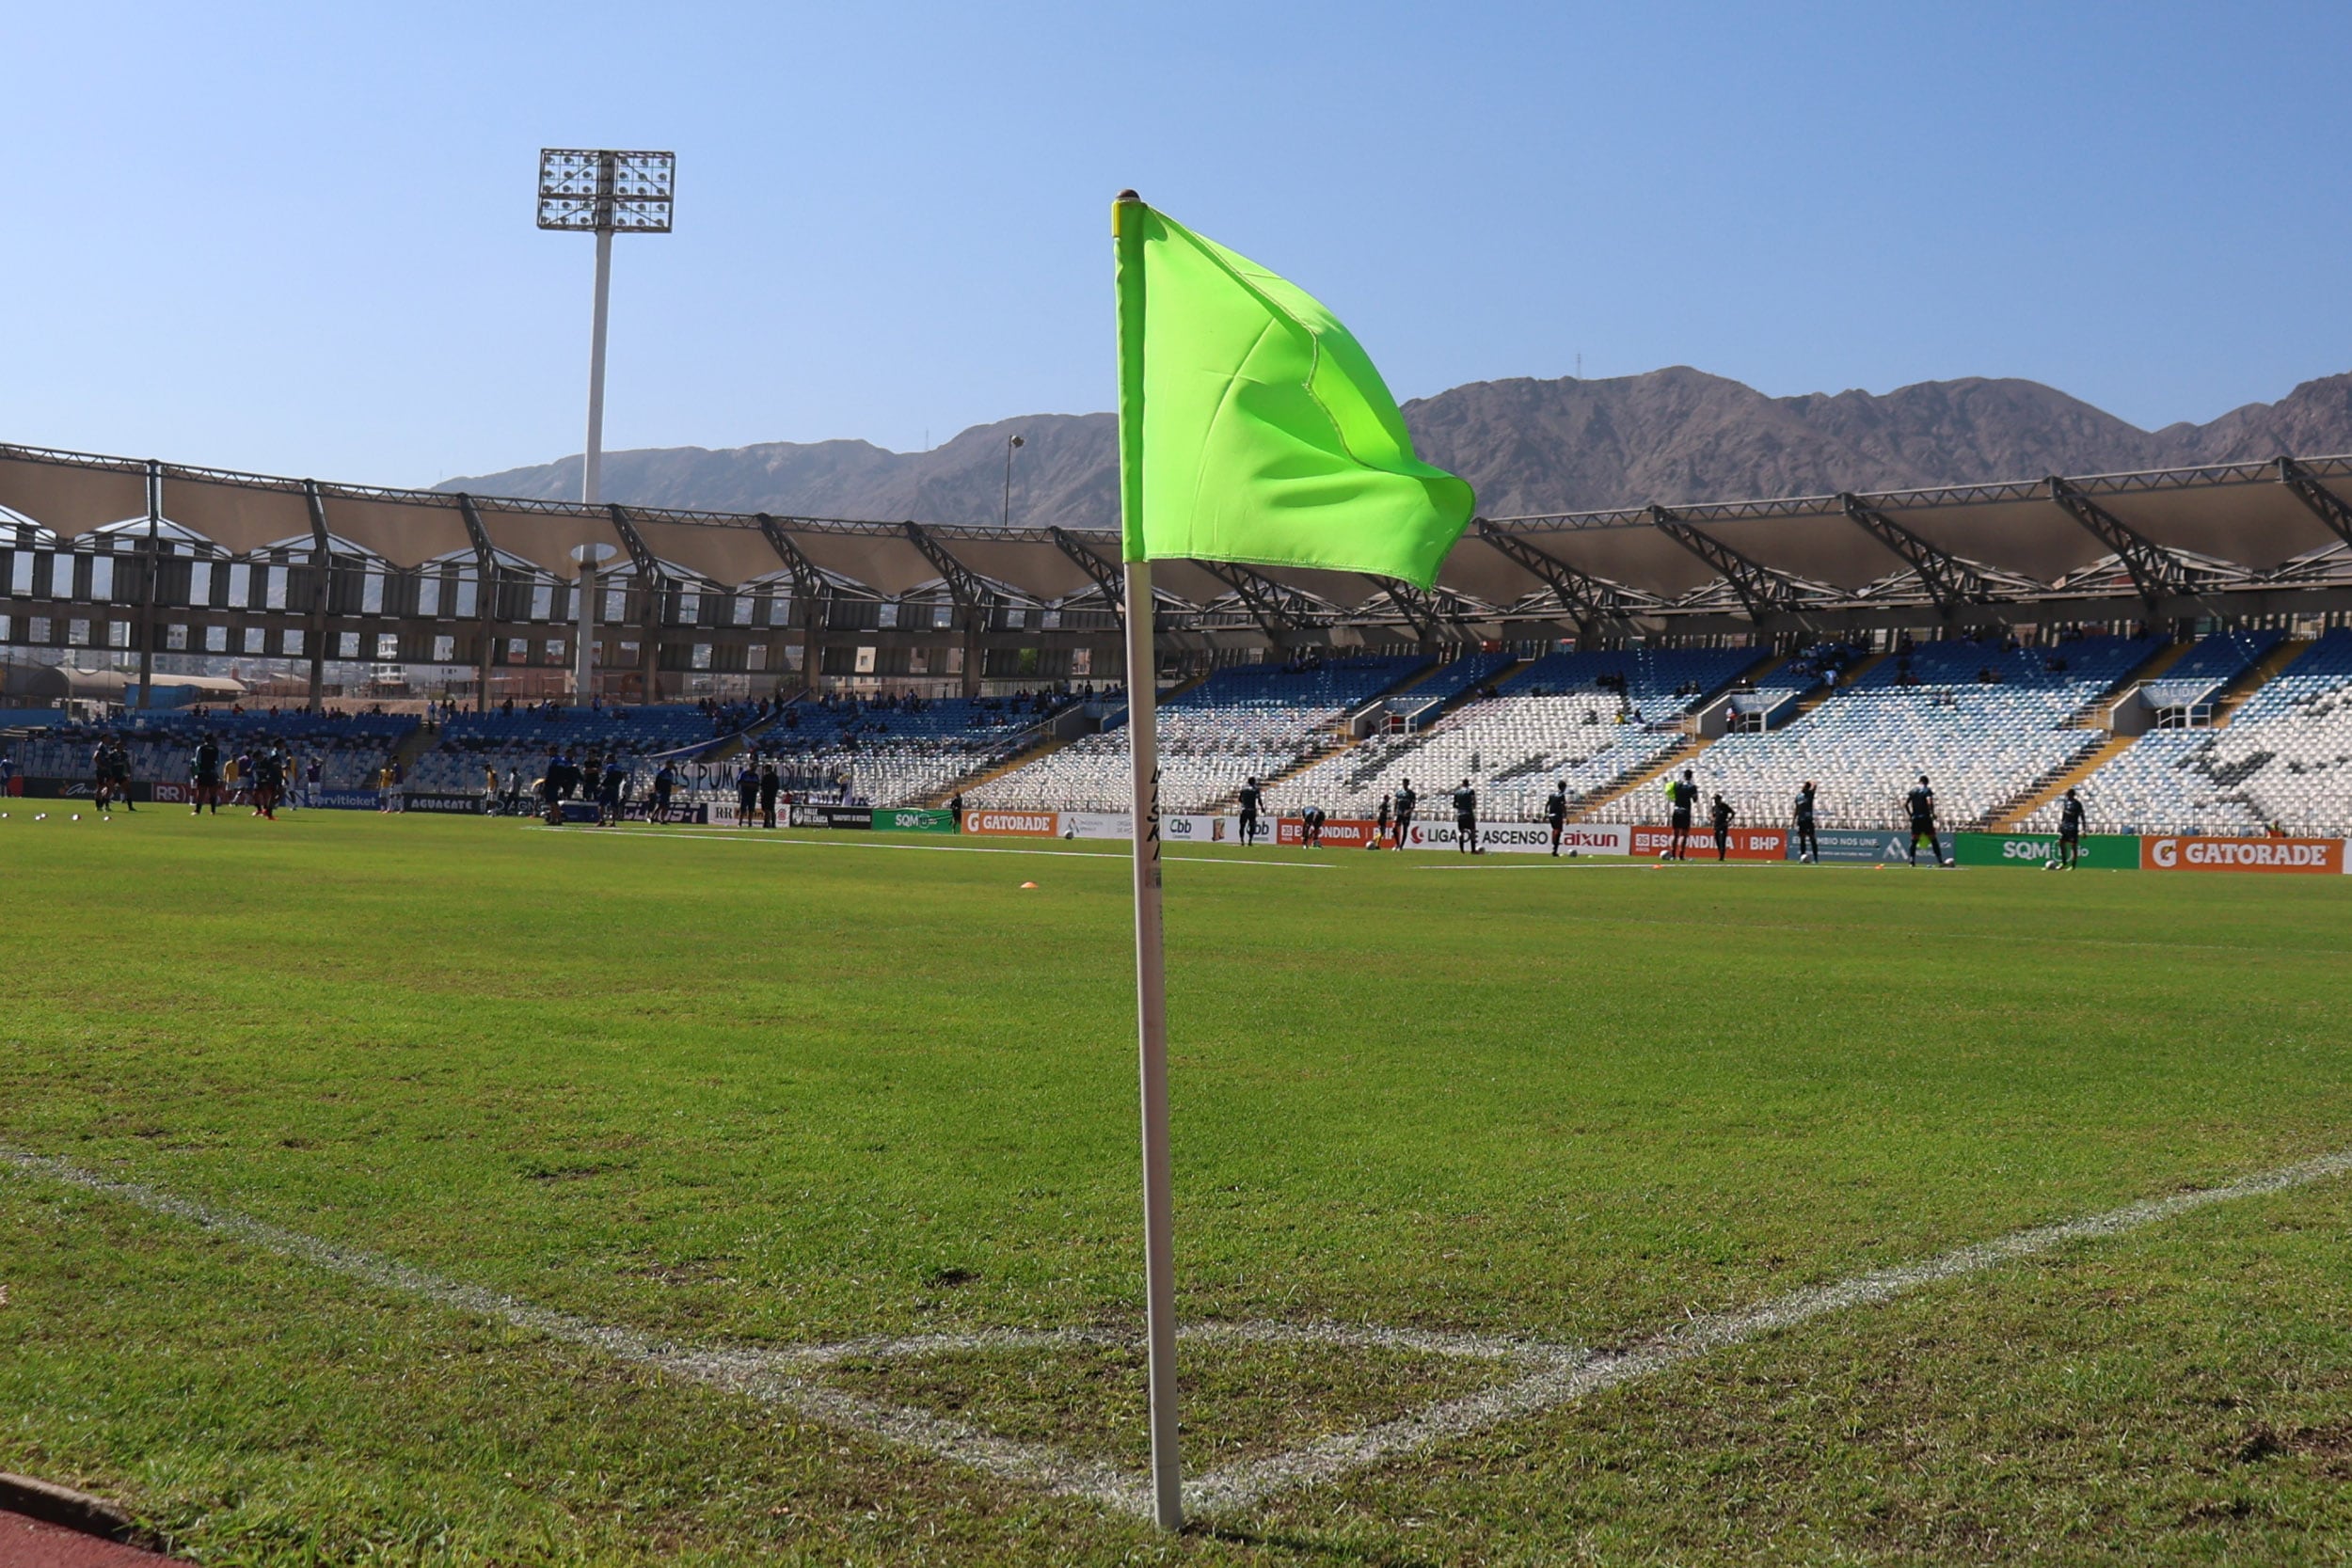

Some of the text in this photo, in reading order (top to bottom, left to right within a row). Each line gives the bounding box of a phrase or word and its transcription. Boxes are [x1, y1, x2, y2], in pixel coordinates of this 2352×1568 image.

[2152, 688, 2199, 698] SALIDA
[410, 799, 472, 811] AGUACATE
[895, 814, 919, 828] SQM
[983, 816, 1050, 832] GATORADE
[1294, 825, 1360, 839] ECONDIDA
[1428, 829, 1457, 842] LIGA
[1482, 831, 1549, 845] ASCENSO
[1651, 834, 1735, 849] ESCONDIA
[1750, 837, 1779, 850] BHP
[2003, 841, 2050, 860] SQM
[2185, 843, 2327, 865] GATORADE
